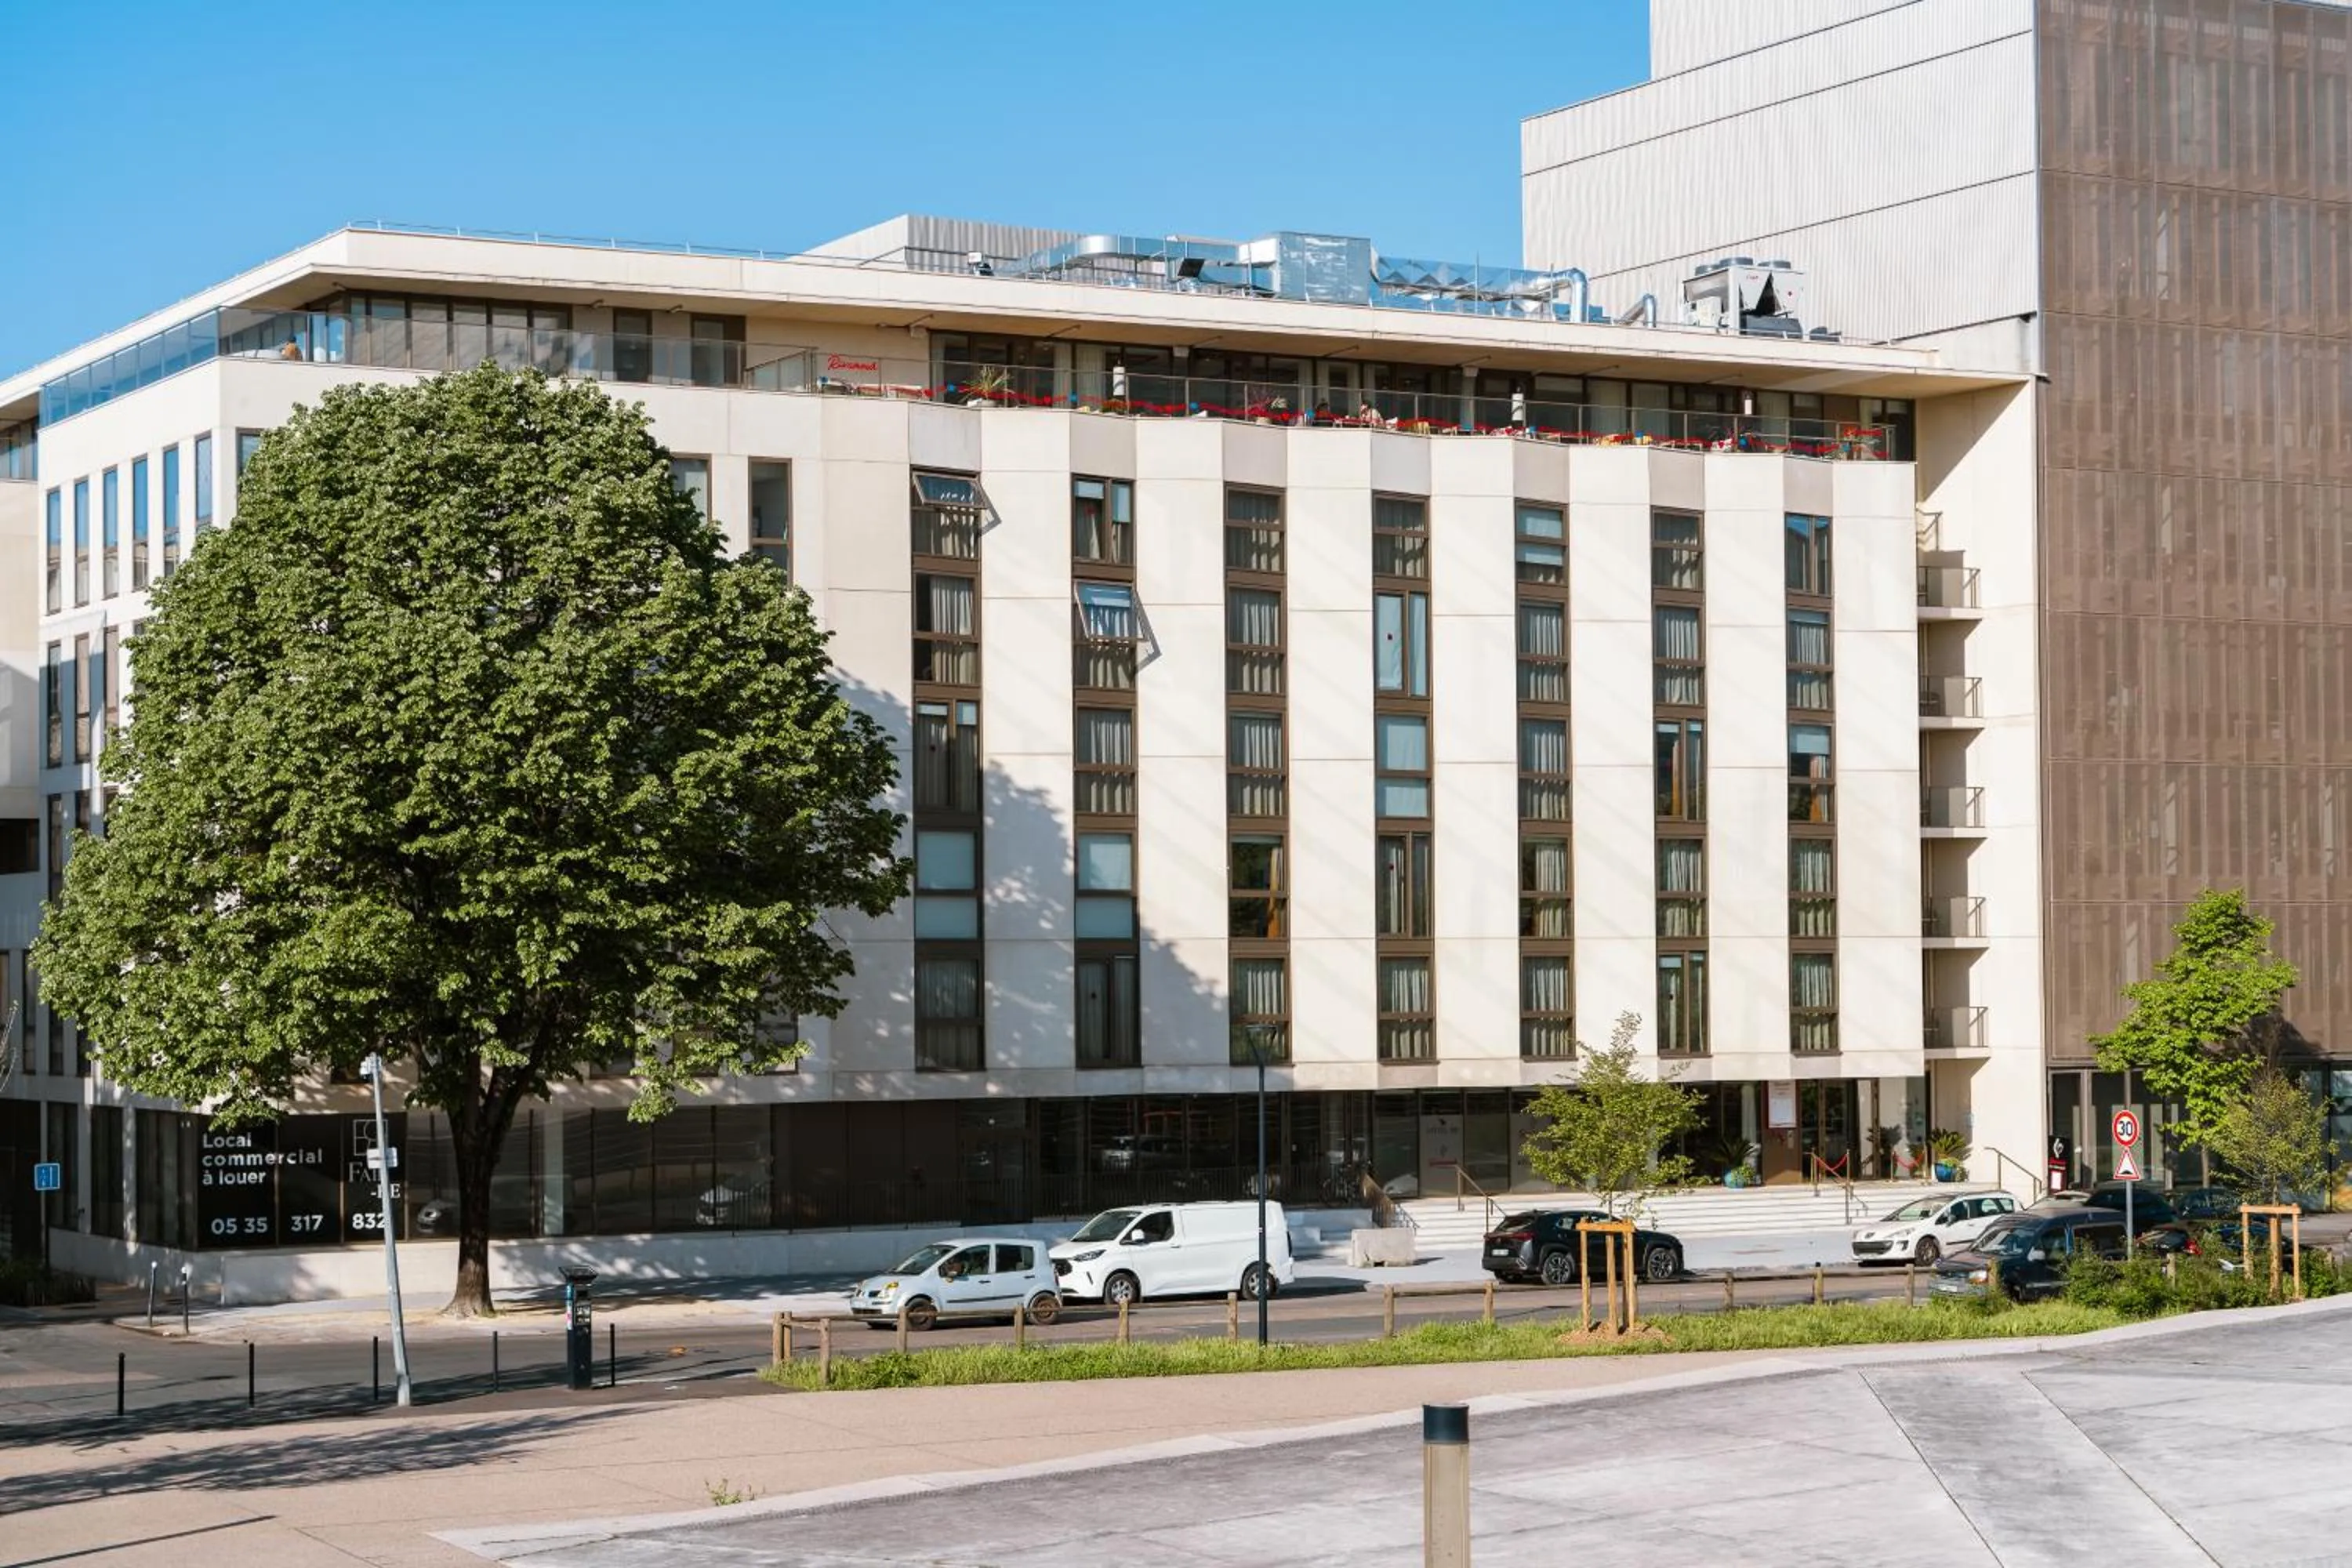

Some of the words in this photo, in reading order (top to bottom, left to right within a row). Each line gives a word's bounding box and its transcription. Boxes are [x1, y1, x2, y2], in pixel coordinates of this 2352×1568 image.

[2118, 1120, 2133, 1136] 30
[202, 1132, 252, 1149] Local
[202, 1148, 323, 1167] commercial
[202, 1170, 213, 1185] à
[219, 1169, 267, 1185] louer
[211, 1217, 238, 1235] 05
[244, 1217, 268, 1234] 35
[291, 1214, 324, 1232] 317
